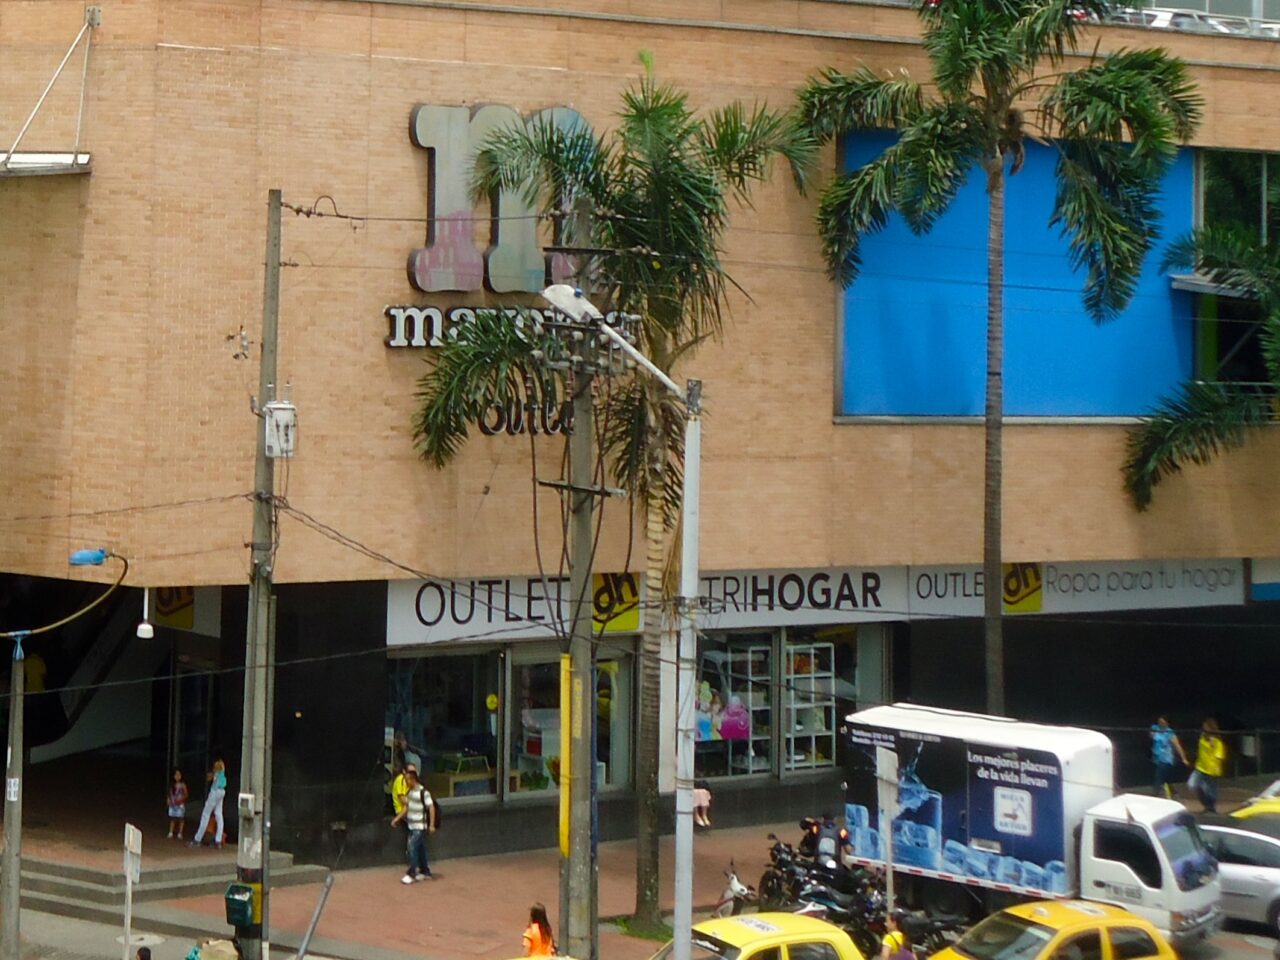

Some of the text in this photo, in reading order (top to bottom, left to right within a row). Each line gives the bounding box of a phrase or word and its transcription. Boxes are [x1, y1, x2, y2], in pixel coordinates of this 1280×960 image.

[916, 570, 985, 599] OUTLE
[1046, 564, 1101, 597] Ropa
[1107, 571, 1153, 597] para
[1158, 568, 1176, 590] tu
[1182, 560, 1236, 591] hogar
[415, 577, 570, 626] OUTLET
[968, 751, 1059, 775] Los mejores placeres
[977, 767, 1049, 788] de la vida llevan
